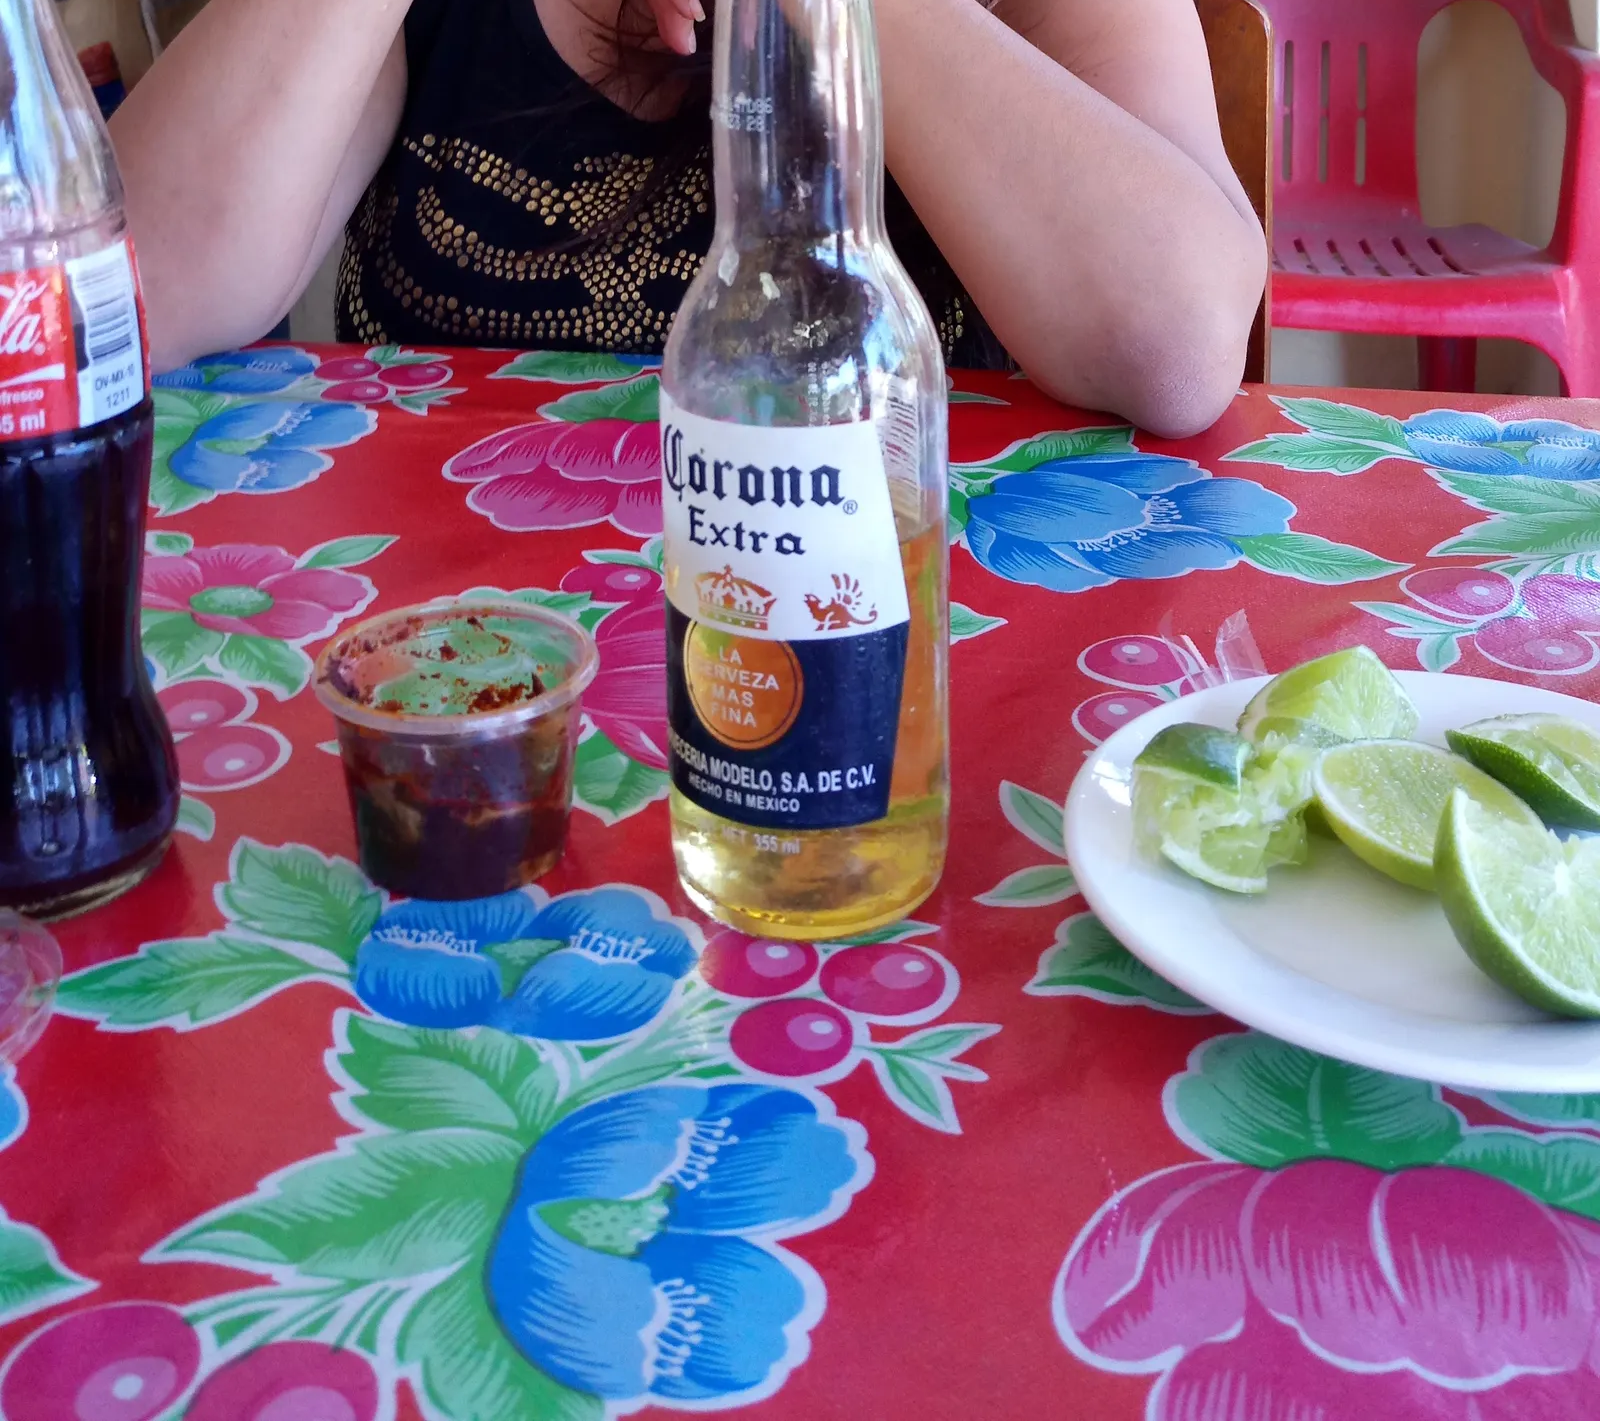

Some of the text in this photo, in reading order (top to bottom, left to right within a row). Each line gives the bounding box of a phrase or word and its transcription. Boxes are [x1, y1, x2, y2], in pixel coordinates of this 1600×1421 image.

[0, 387, 45, 406] fresco
[106, 386, 130, 409] 1211
[0, 409, 46, 435] 5 ml
[664, 424, 846, 508] Corona
[687, 504, 806, 556] Extra
[719, 645, 743, 666] LA
[699, 661, 780, 691] ERVEZA
[711, 683, 754, 708] MAS
[711, 700, 757, 729] FINA
[709, 756, 777, 796] MODELO,
[780, 770, 814, 794] S.A.
[818, 769, 842, 793] DE
[846, 763, 876, 789] C.V.
[688, 771, 800, 813] HECHO EN MEXICO
[753, 833, 778, 853] 355
[783, 837, 801, 855] ml
